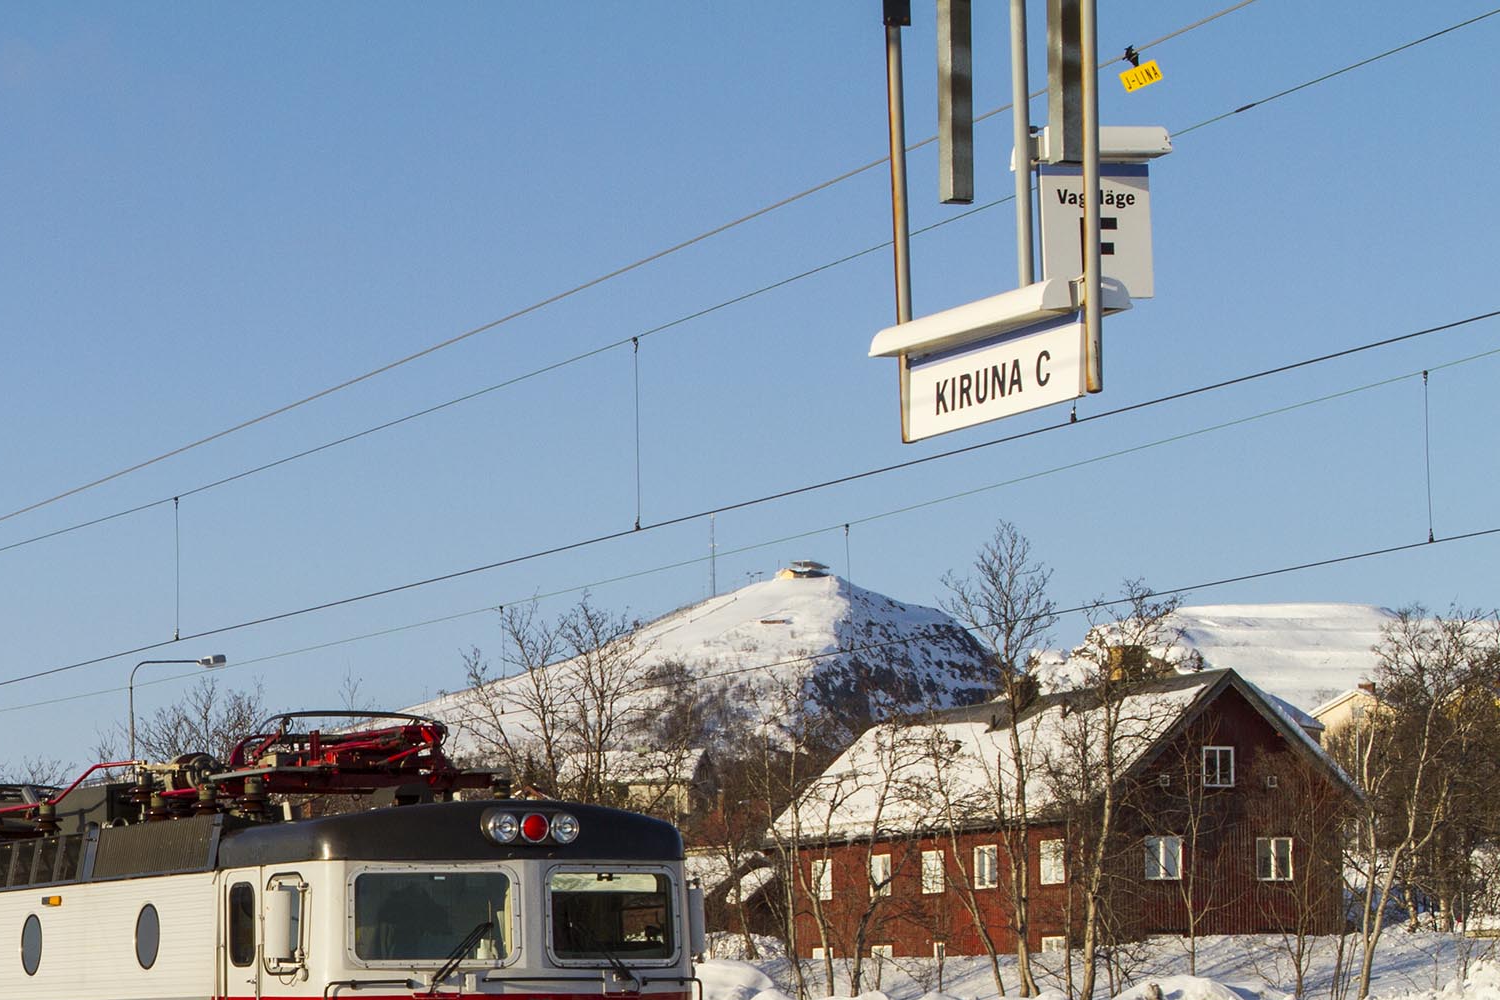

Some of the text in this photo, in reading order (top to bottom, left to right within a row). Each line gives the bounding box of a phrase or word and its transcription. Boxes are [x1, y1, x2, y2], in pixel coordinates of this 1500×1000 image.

[1057, 189, 1135, 208] Vagläge
[935, 350, 1051, 416] KIRUNA C
